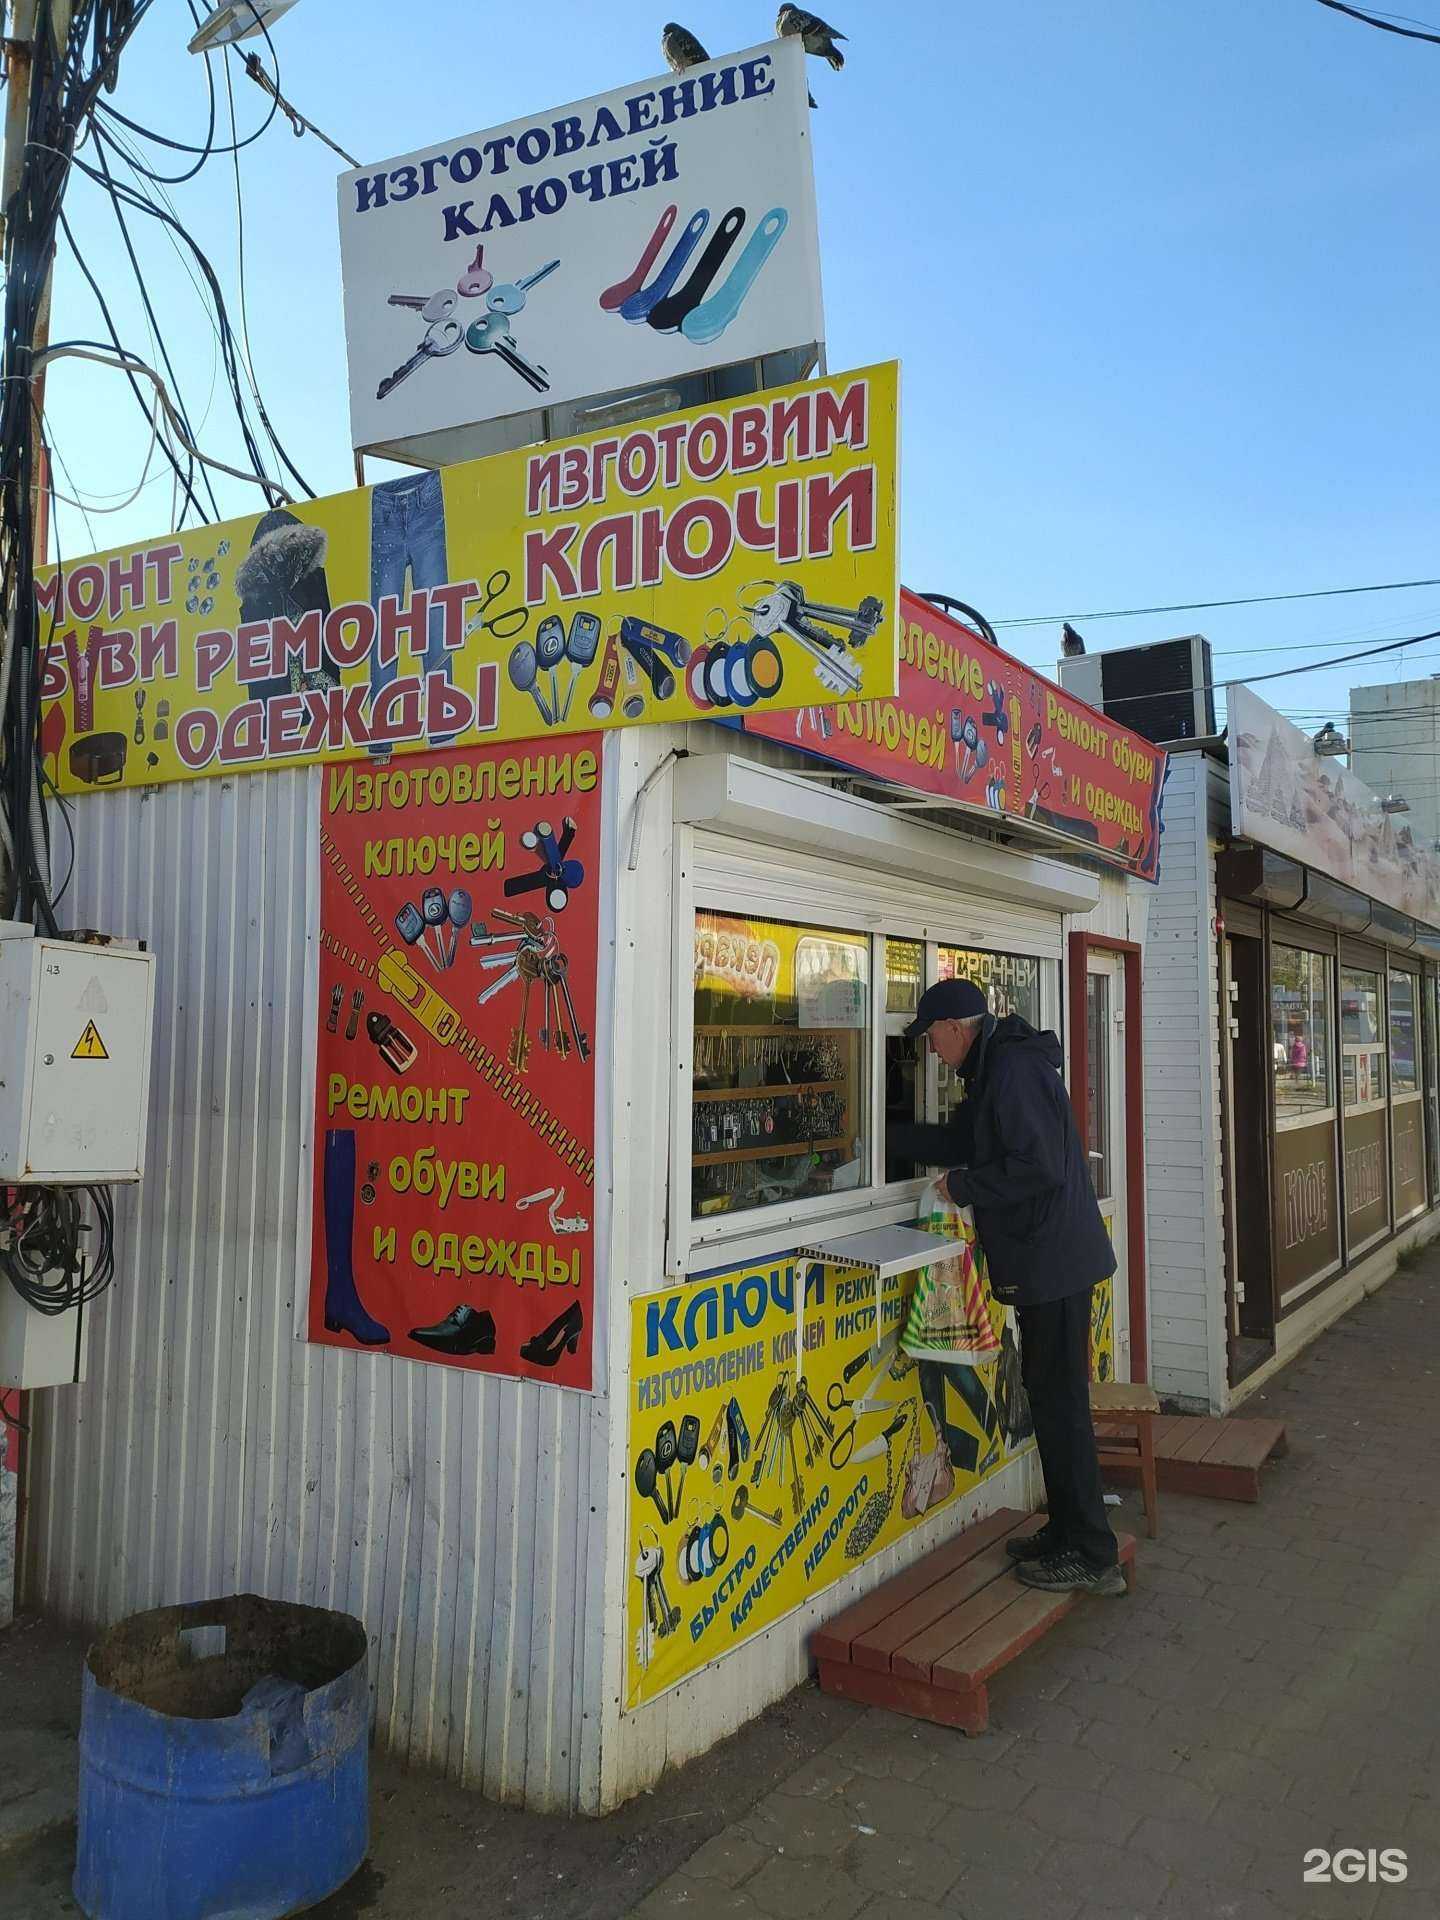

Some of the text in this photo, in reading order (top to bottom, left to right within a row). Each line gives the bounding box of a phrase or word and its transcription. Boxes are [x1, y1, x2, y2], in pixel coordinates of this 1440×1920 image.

[355, 55, 776, 212] ИЗГОТОВЛЕНИЕ
[442, 136, 680, 241] КЛЮЧЕЙ
[527, 382, 867, 515] ИЗГОТОВИМ
[525, 468, 875, 605] КЛЮЧИ
[33, 543, 184, 627] МОНТ
[39, 620, 179, 700] БУВИ
[195, 580, 481, 690] РЕМОНТ
[174, 663, 498, 770] ОДЕЖДЫ
[836, 699, 946, 771] ключей
[1046, 690, 1153, 784] Ремонт обуви
[328, 750, 598, 814] Изготовление
[1071, 773, 1144, 834] и одежды
[364, 818, 506, 877] ключей
[46, 965, 60, 976] 43
[328, 1073, 470, 1123] Ремонт
[388, 1145, 505, 1209] обуви
[373, 1226, 581, 1288] и одежды
[646, 1262, 825, 1357] КЛЮЧИ
[638, 1341, 765, 1413] ИЗГОТОВЛЕНИЕ
[730, 1484, 830, 1632] КАЧЕСТВЕННО
[803, 1474, 868, 1582] НЕДОРОГО
[689, 1544, 757, 1644] БЫСТРО
